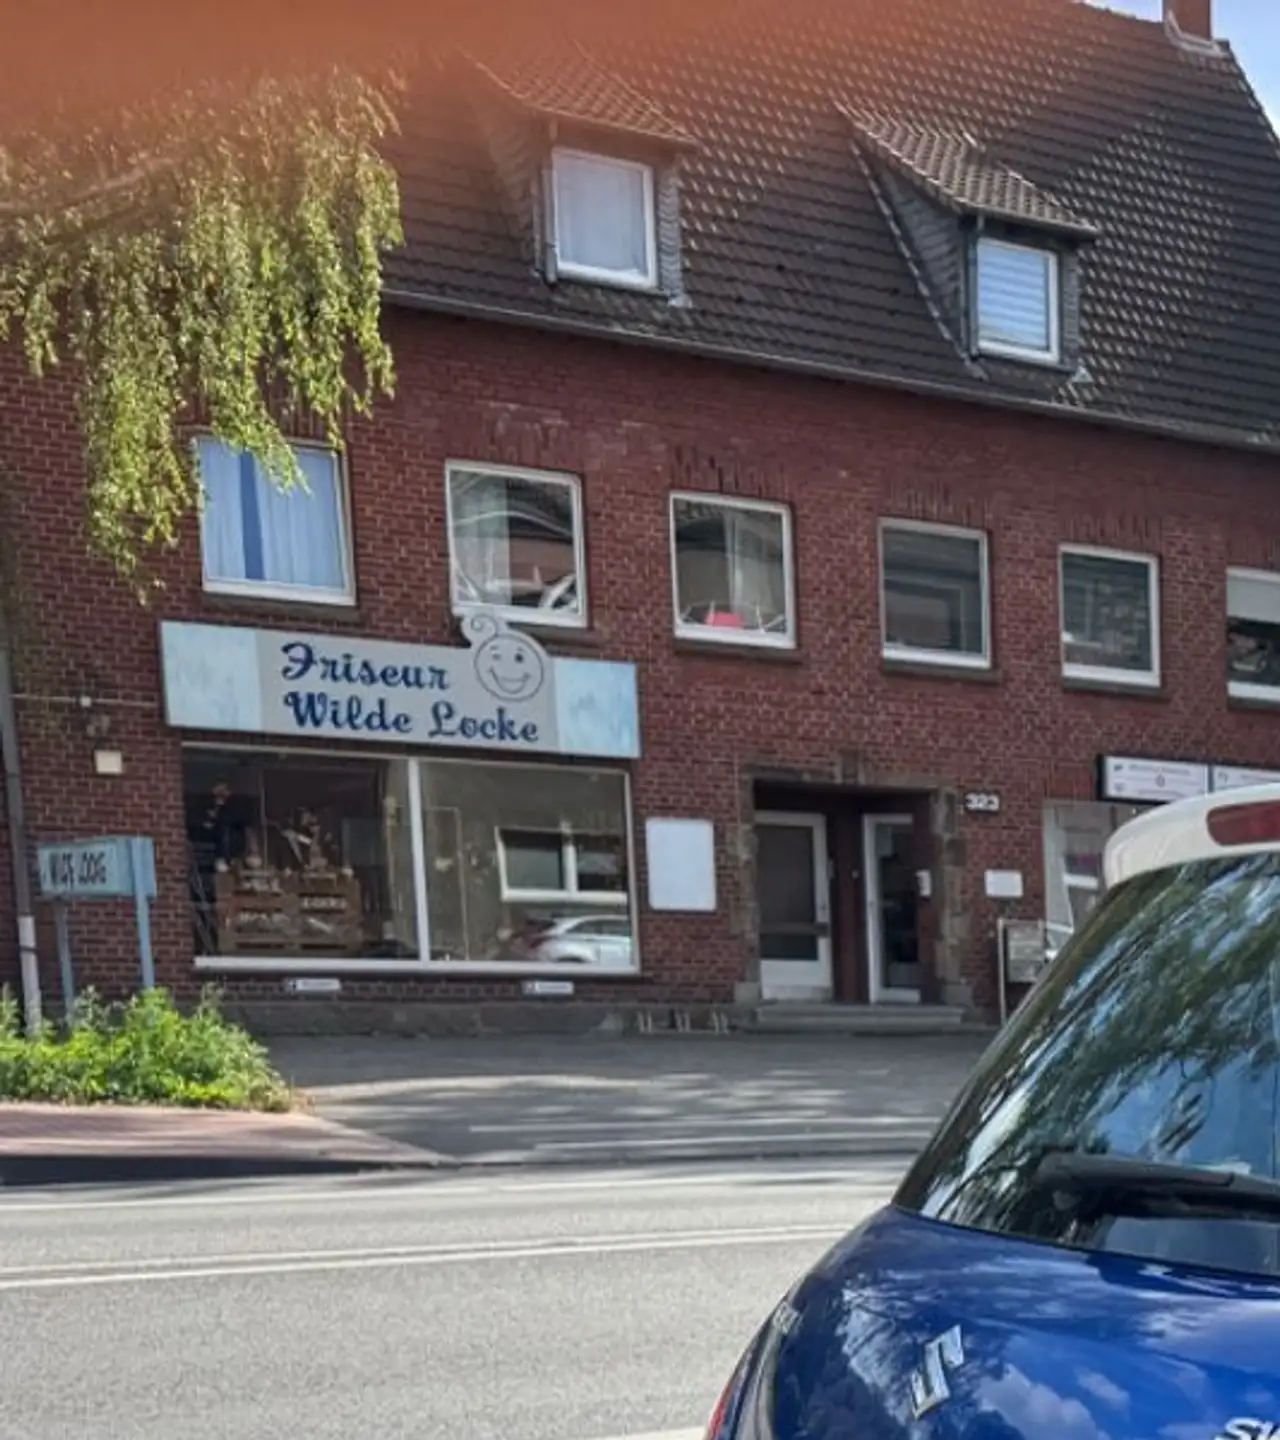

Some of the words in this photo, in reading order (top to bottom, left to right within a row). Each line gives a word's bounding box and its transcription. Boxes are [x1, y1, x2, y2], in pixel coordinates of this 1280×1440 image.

[281, 641, 449, 690] Friseur
[283, 690, 413, 732] Wilde
[428, 699, 539, 743] Locke
